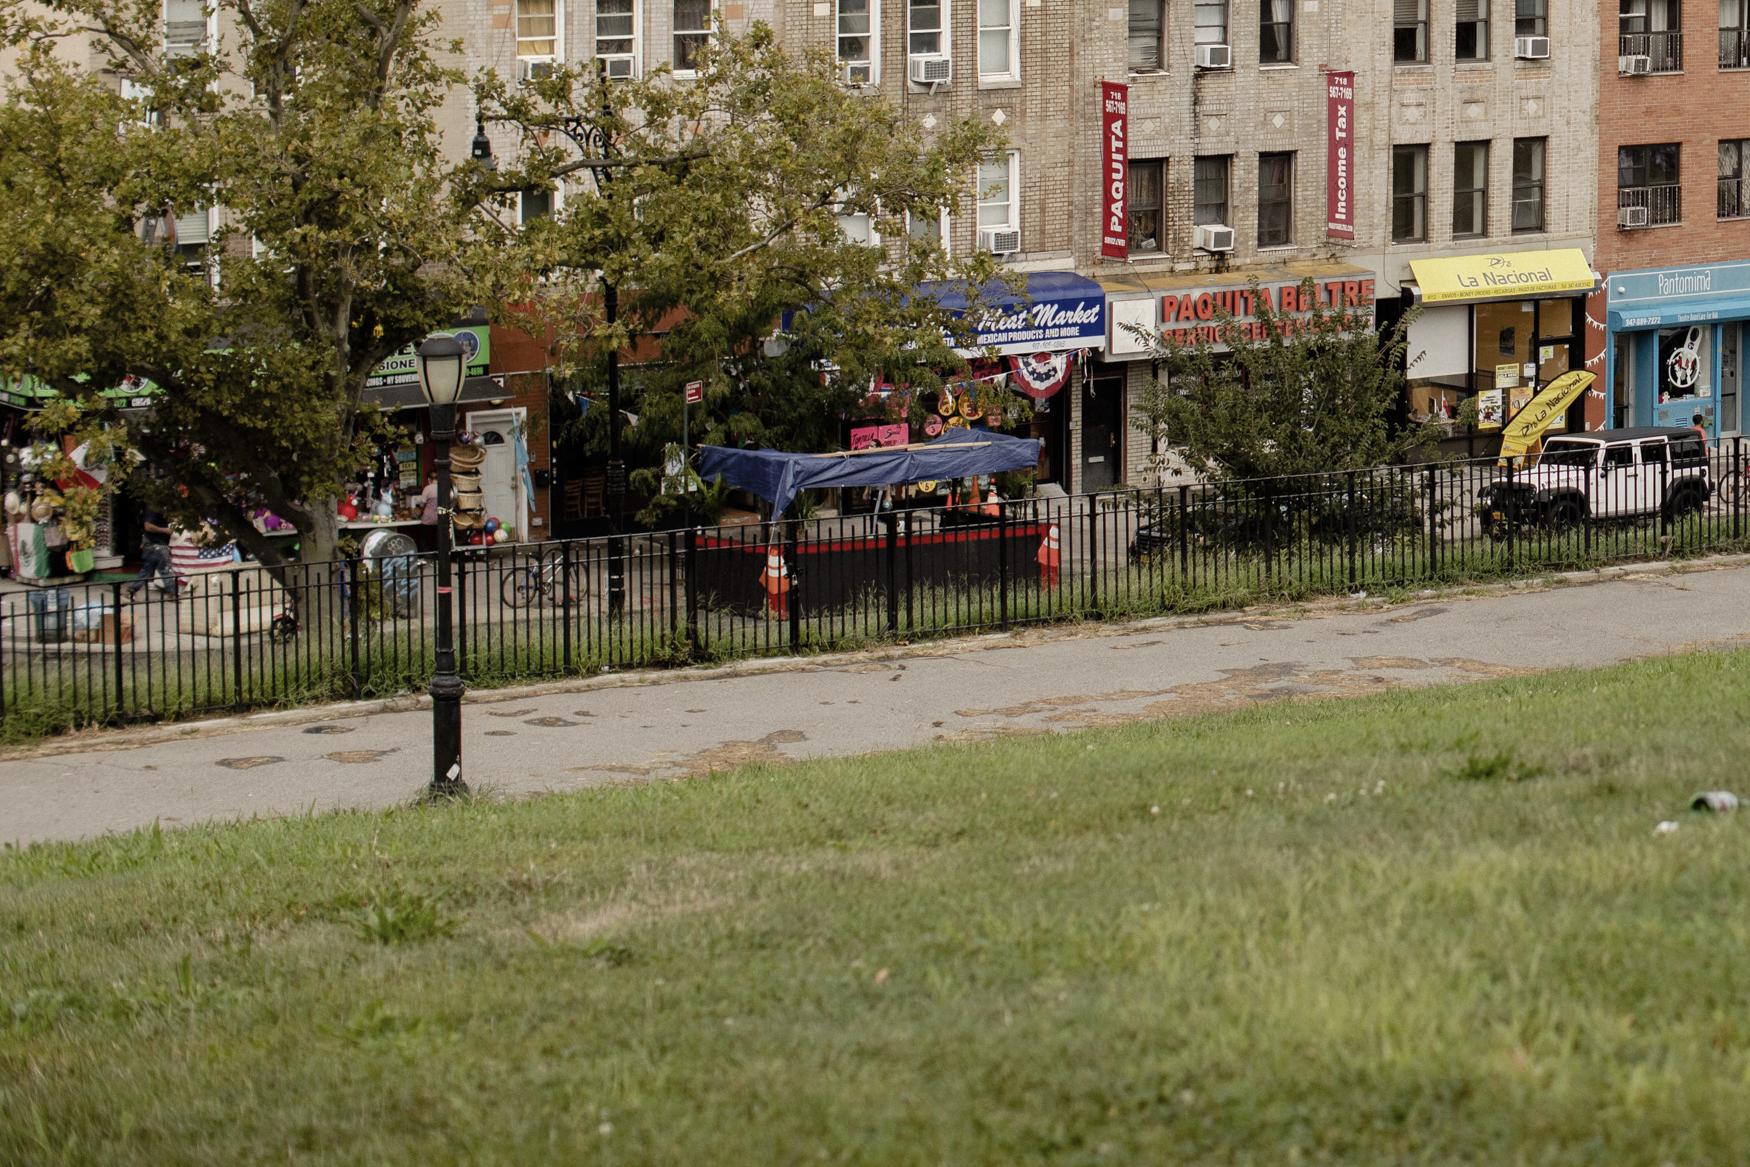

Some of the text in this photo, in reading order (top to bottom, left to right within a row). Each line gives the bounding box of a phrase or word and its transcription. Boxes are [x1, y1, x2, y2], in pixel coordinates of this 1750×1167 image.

[1334, 77, 1348, 85] 718
[1110, 91, 1122, 100] 718
[1110, 119, 1124, 233] PAQUITA
[1335, 105, 1347, 220] Income Tax
[1457, 268, 1553, 289] La Nacional
[1658, 270, 1711, 295] Pantomima
[1162, 279, 1375, 323] PAQUITA BELTRE
[977, 301, 1100, 332] Meat Market
[977, 326, 1080, 345] MEXICAN PRODUCTS AND MORE
[1535, 373, 1583, 423] La Nacional
